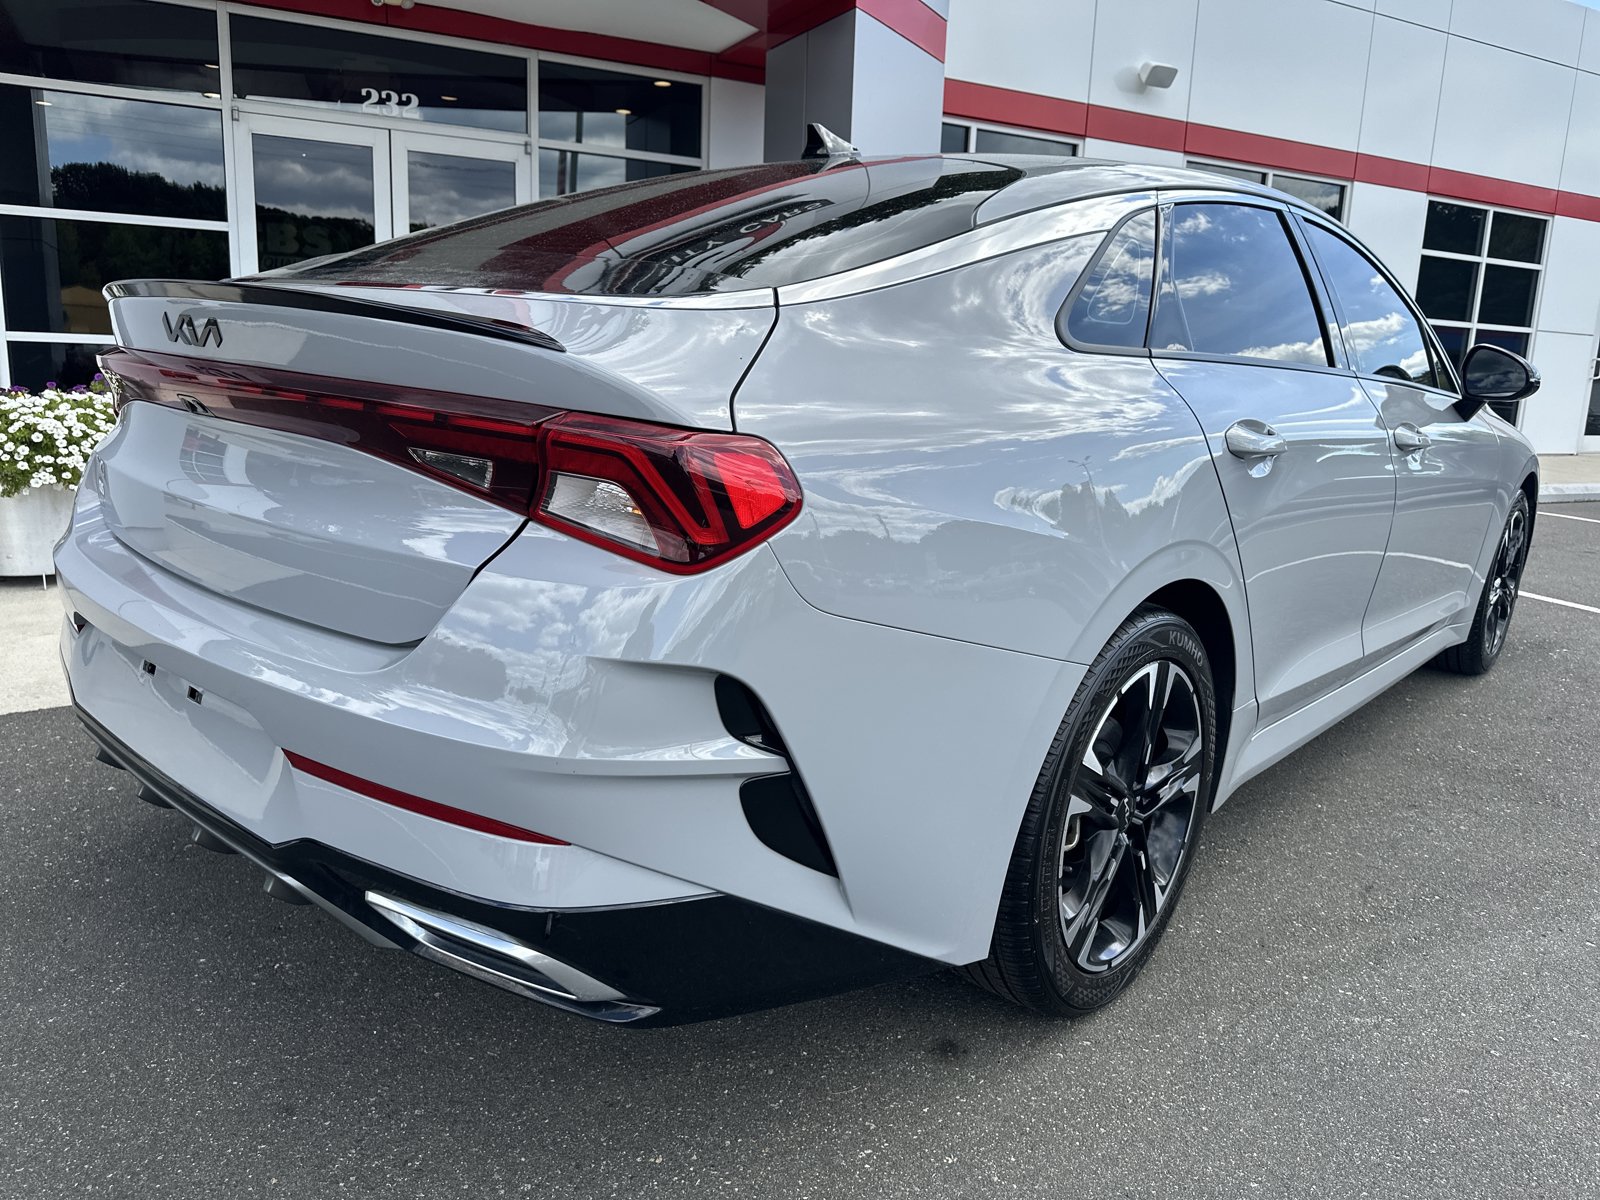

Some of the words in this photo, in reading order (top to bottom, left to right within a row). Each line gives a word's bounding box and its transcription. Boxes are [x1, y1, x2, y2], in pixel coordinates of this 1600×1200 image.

[361, 88, 420, 120] 232
[162, 312, 223, 348] KIA
[1169, 630, 1203, 667] KUMHO
